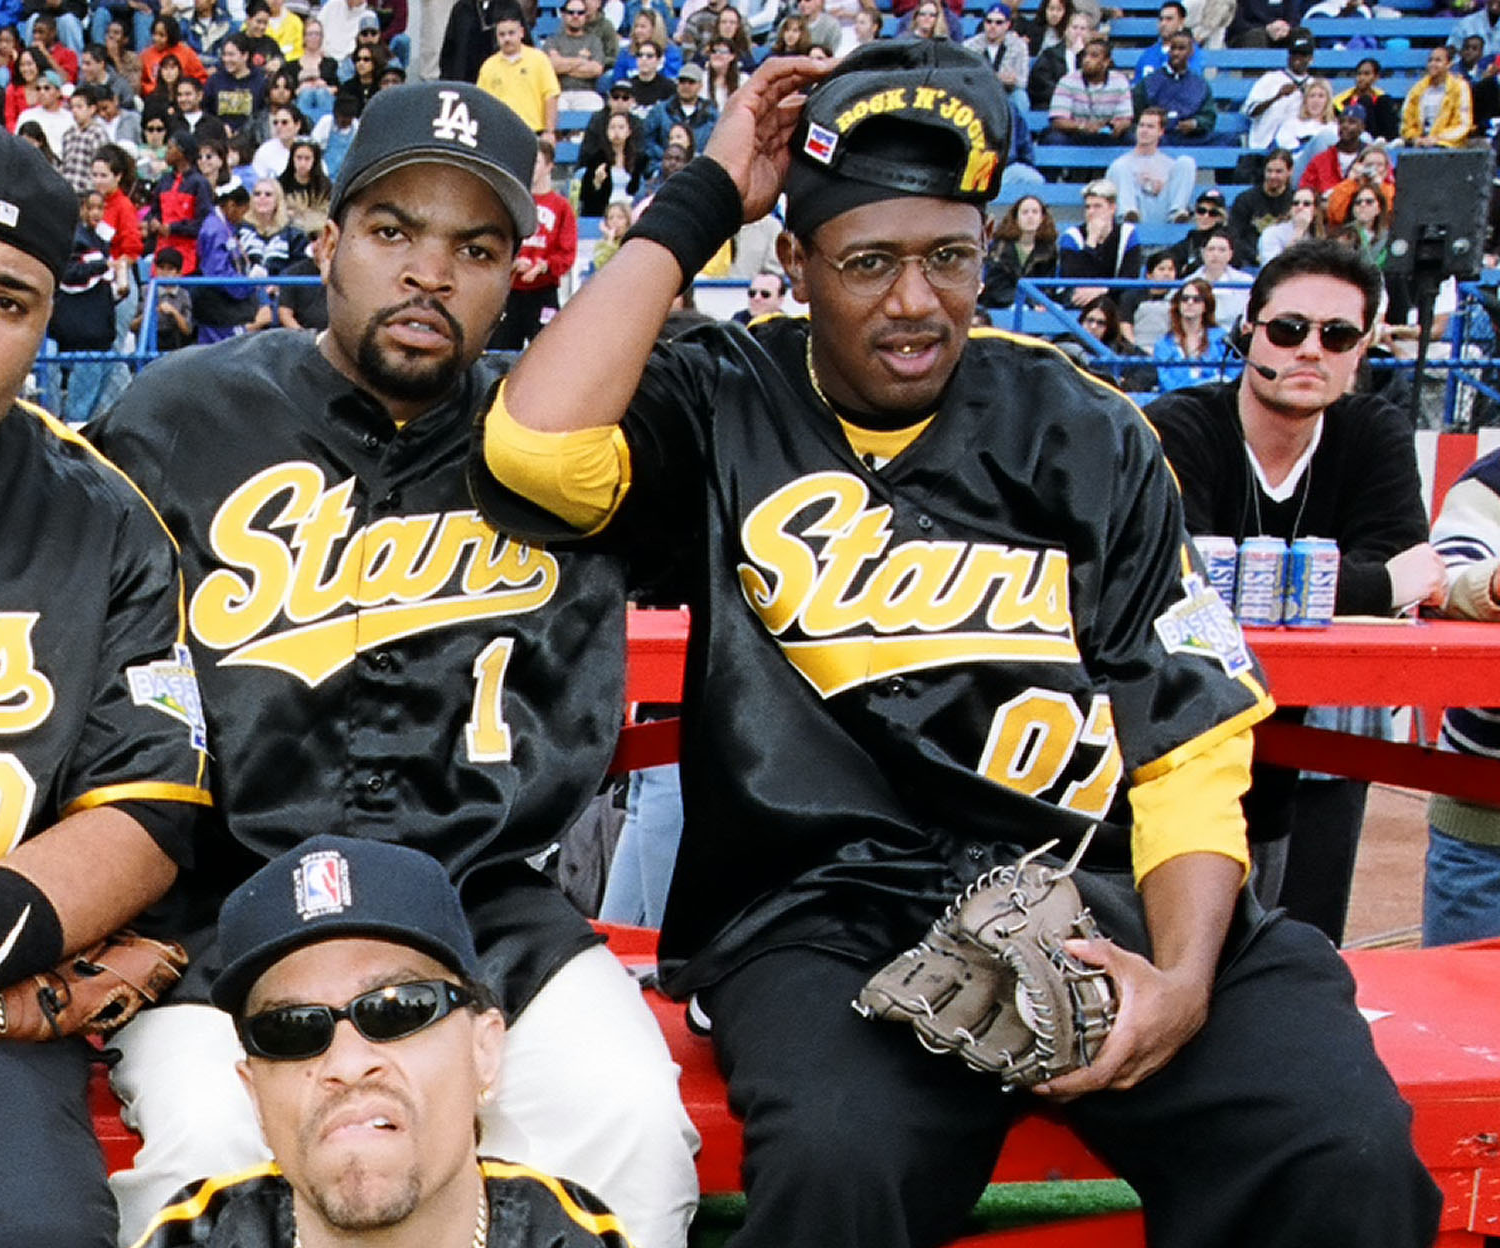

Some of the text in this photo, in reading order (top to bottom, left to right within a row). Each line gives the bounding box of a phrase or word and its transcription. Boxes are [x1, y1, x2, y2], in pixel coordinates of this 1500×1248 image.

[432, 90, 479, 149] LA
[835, 87, 907, 134] ROCK
[189, 461, 561, 652] Stars
[736, 469, 1077, 638] Stars
[464, 637, 515, 763] 1
[975, 686, 1124, 823] 07
